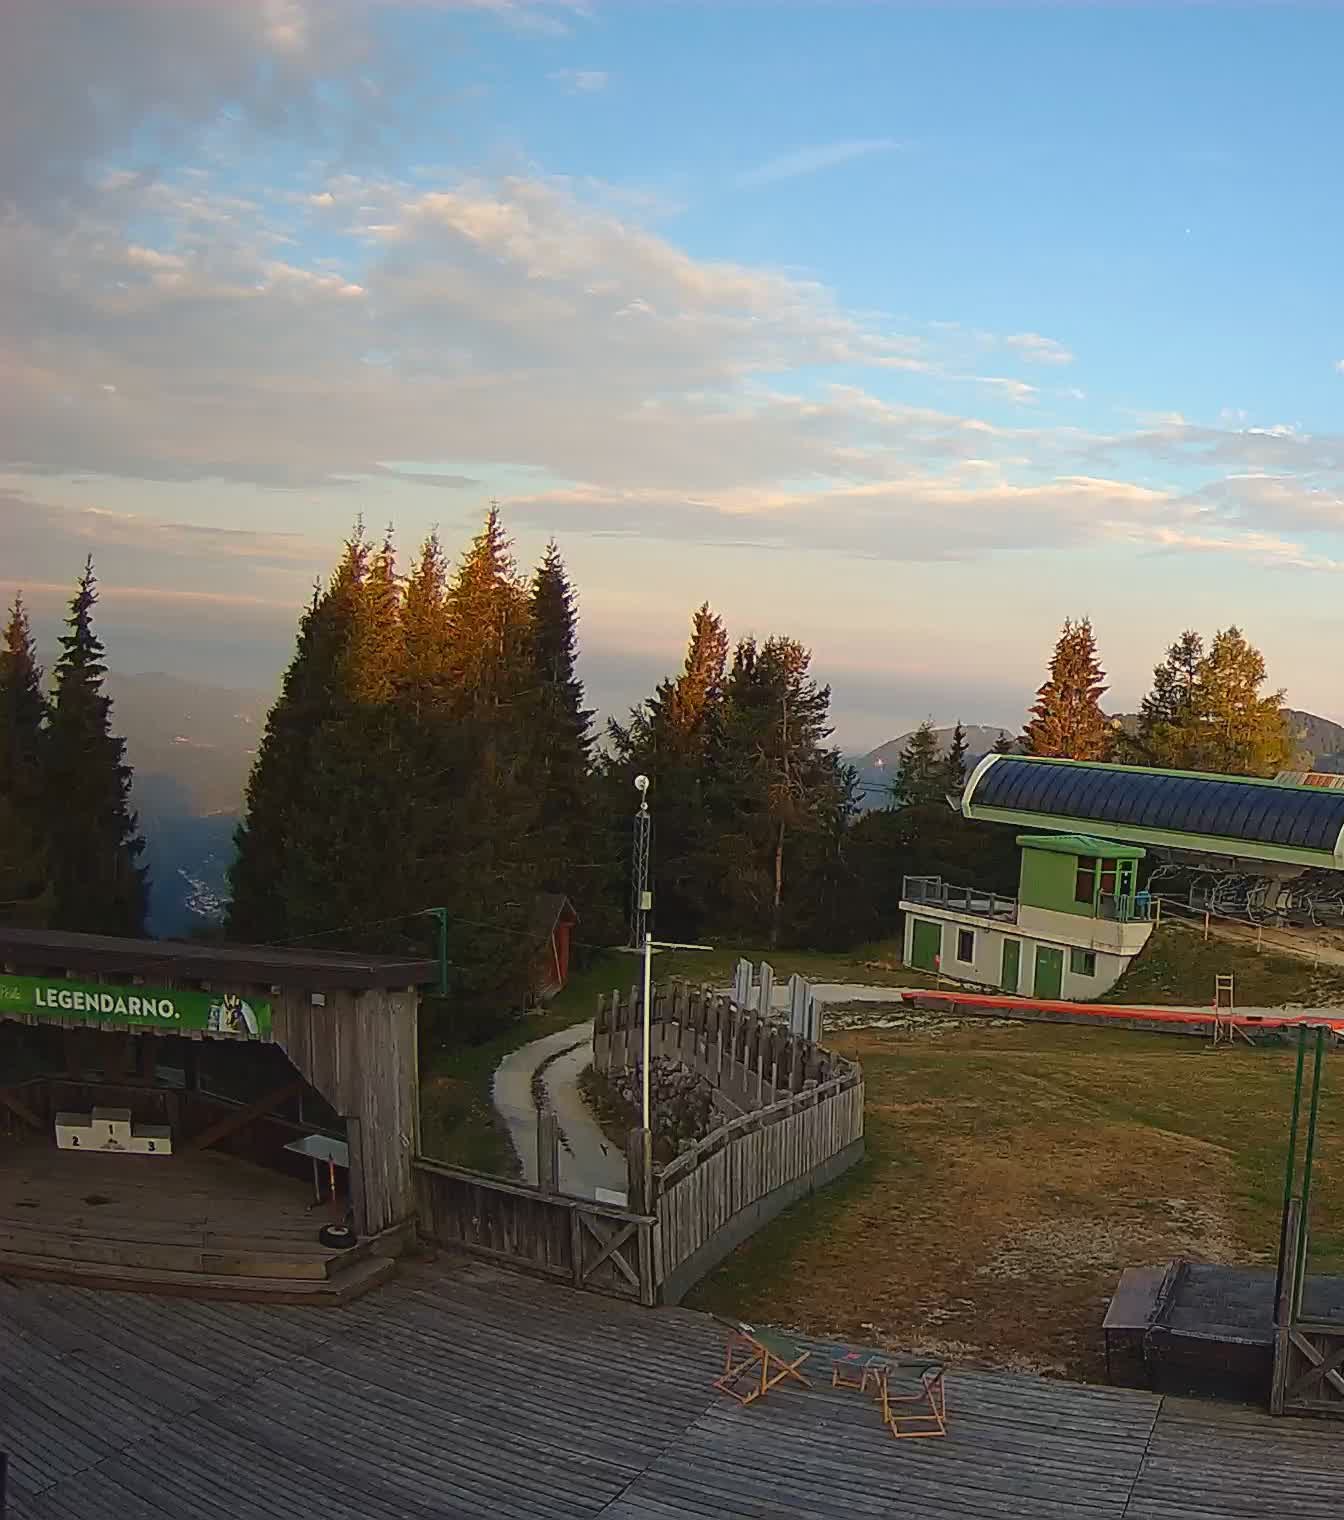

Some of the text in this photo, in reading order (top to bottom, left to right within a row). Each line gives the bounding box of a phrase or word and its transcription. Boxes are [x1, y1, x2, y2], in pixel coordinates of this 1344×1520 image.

[35, 988, 180, 1019] LEGENDARNO.
[108, 1124, 114, 1135] 1
[72, 1136, 80, 1146] 2
[148, 1141, 156, 1151] 3
